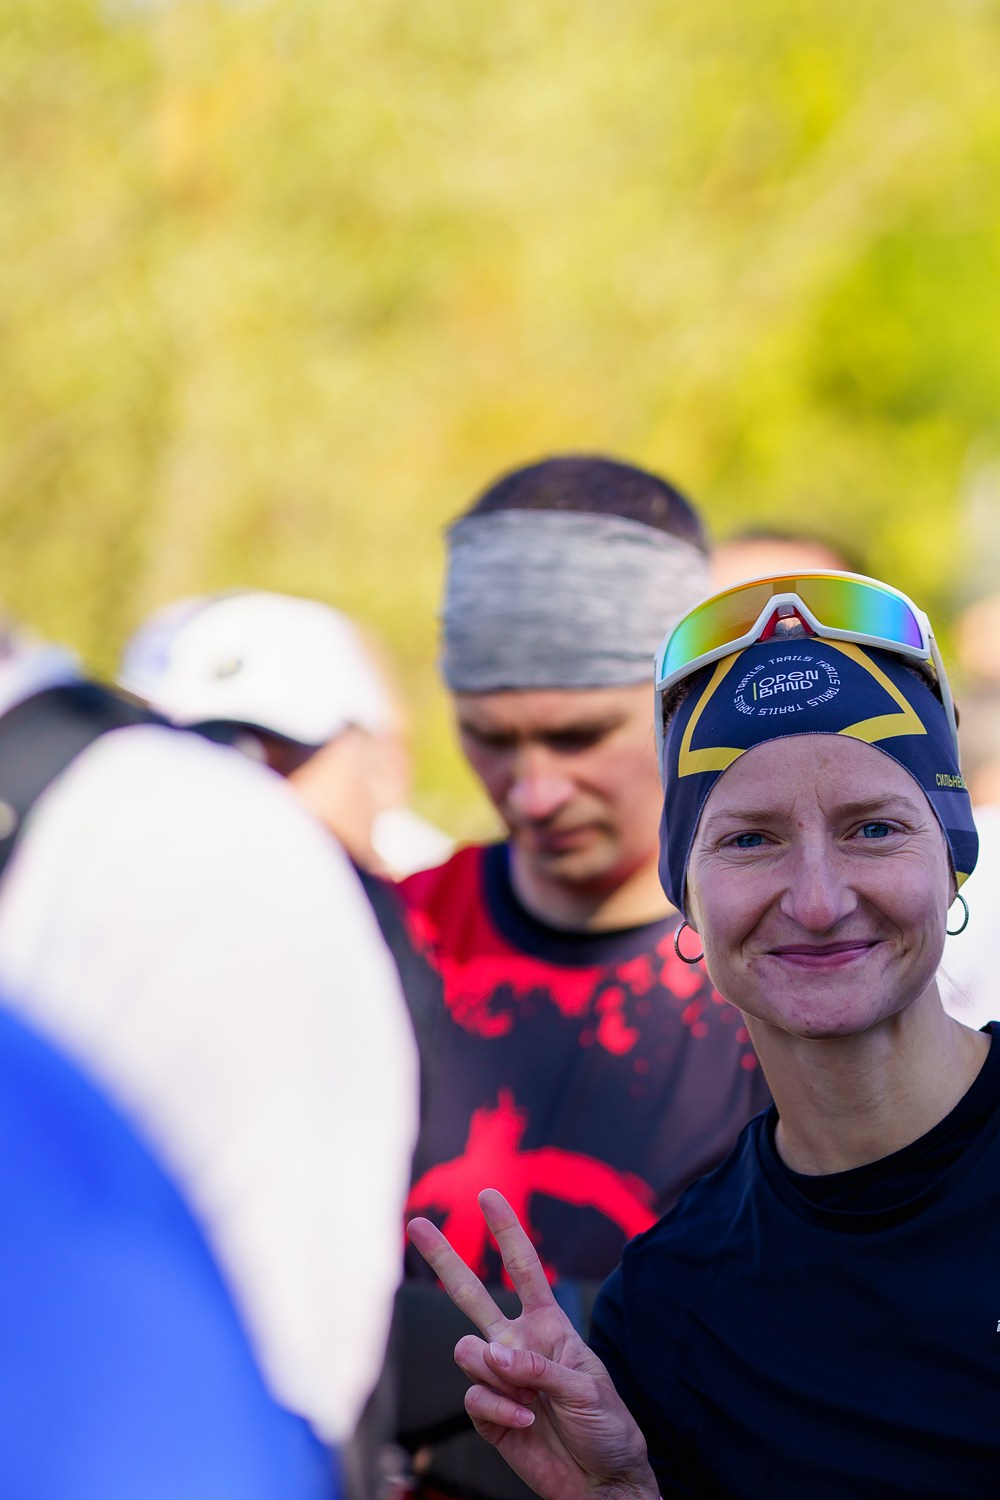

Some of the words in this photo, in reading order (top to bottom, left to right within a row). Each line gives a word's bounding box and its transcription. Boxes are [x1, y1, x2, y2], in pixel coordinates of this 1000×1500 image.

[768, 655, 813, 665] TRAILS
[735, 664, 765, 694] TRAILS
[816, 660, 841, 685] TRAILS
[759, 680, 813, 699] BAND
[806, 686, 839, 707] TRAILS
[733, 695, 755, 715] TRAILS
[758, 703, 804, 716] TRAILS
